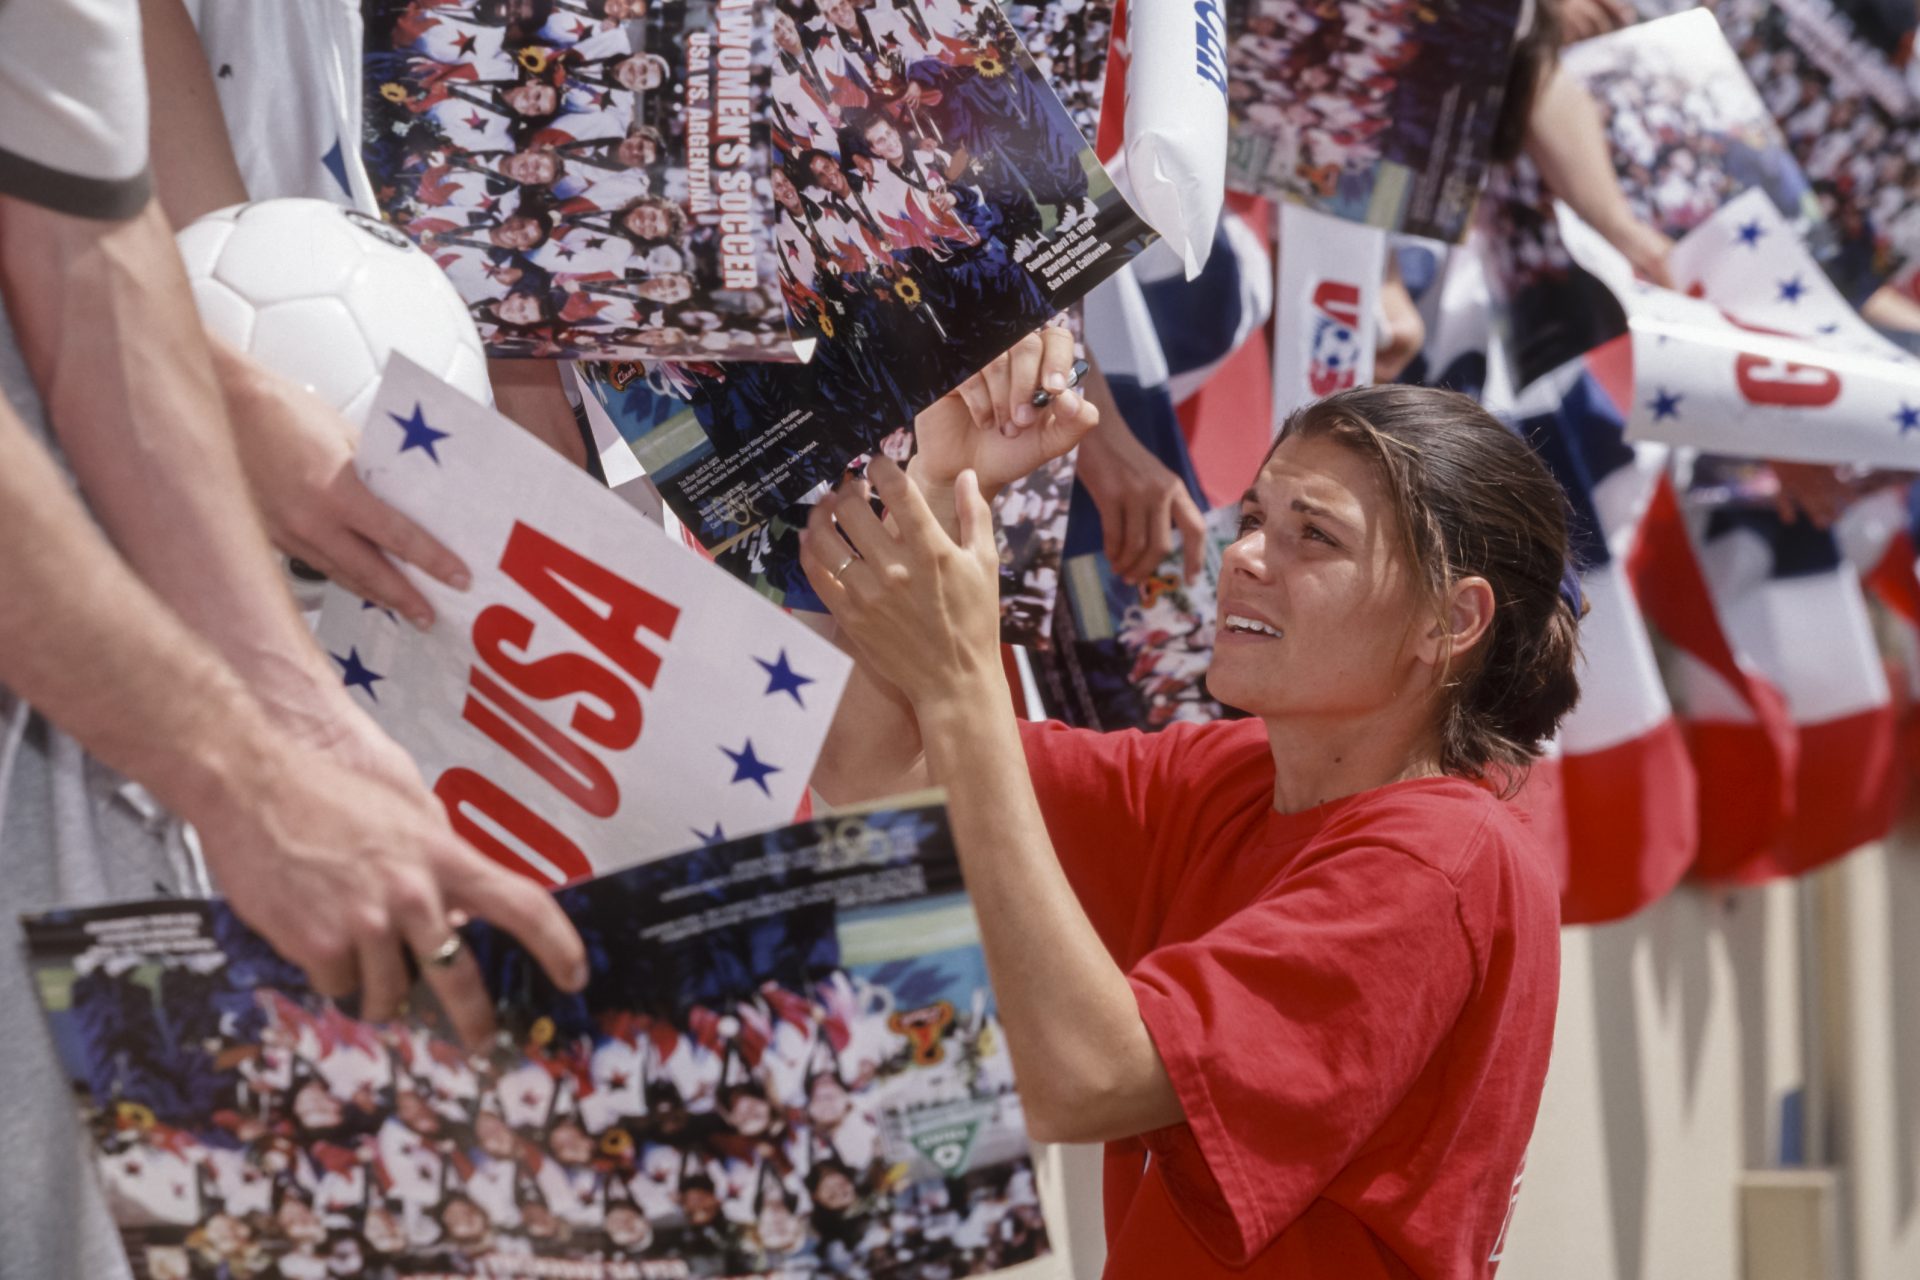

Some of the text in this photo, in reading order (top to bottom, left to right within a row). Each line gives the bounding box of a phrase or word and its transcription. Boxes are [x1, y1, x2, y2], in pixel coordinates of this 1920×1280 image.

[687, 33, 711, 215] USA VS. ARGENTINA
[716, 14, 752, 166] WOMEN'S
[716, 171, 758, 291] SOCCER
[1025, 248, 1054, 272] Sunday,
[1050, 237, 1069, 254] April
[1041, 234, 1096, 278] Spartan Stadium
[1046, 275, 1063, 291] San
[1075, 240, 1111, 269] California
[461, 519, 682, 819] USA
